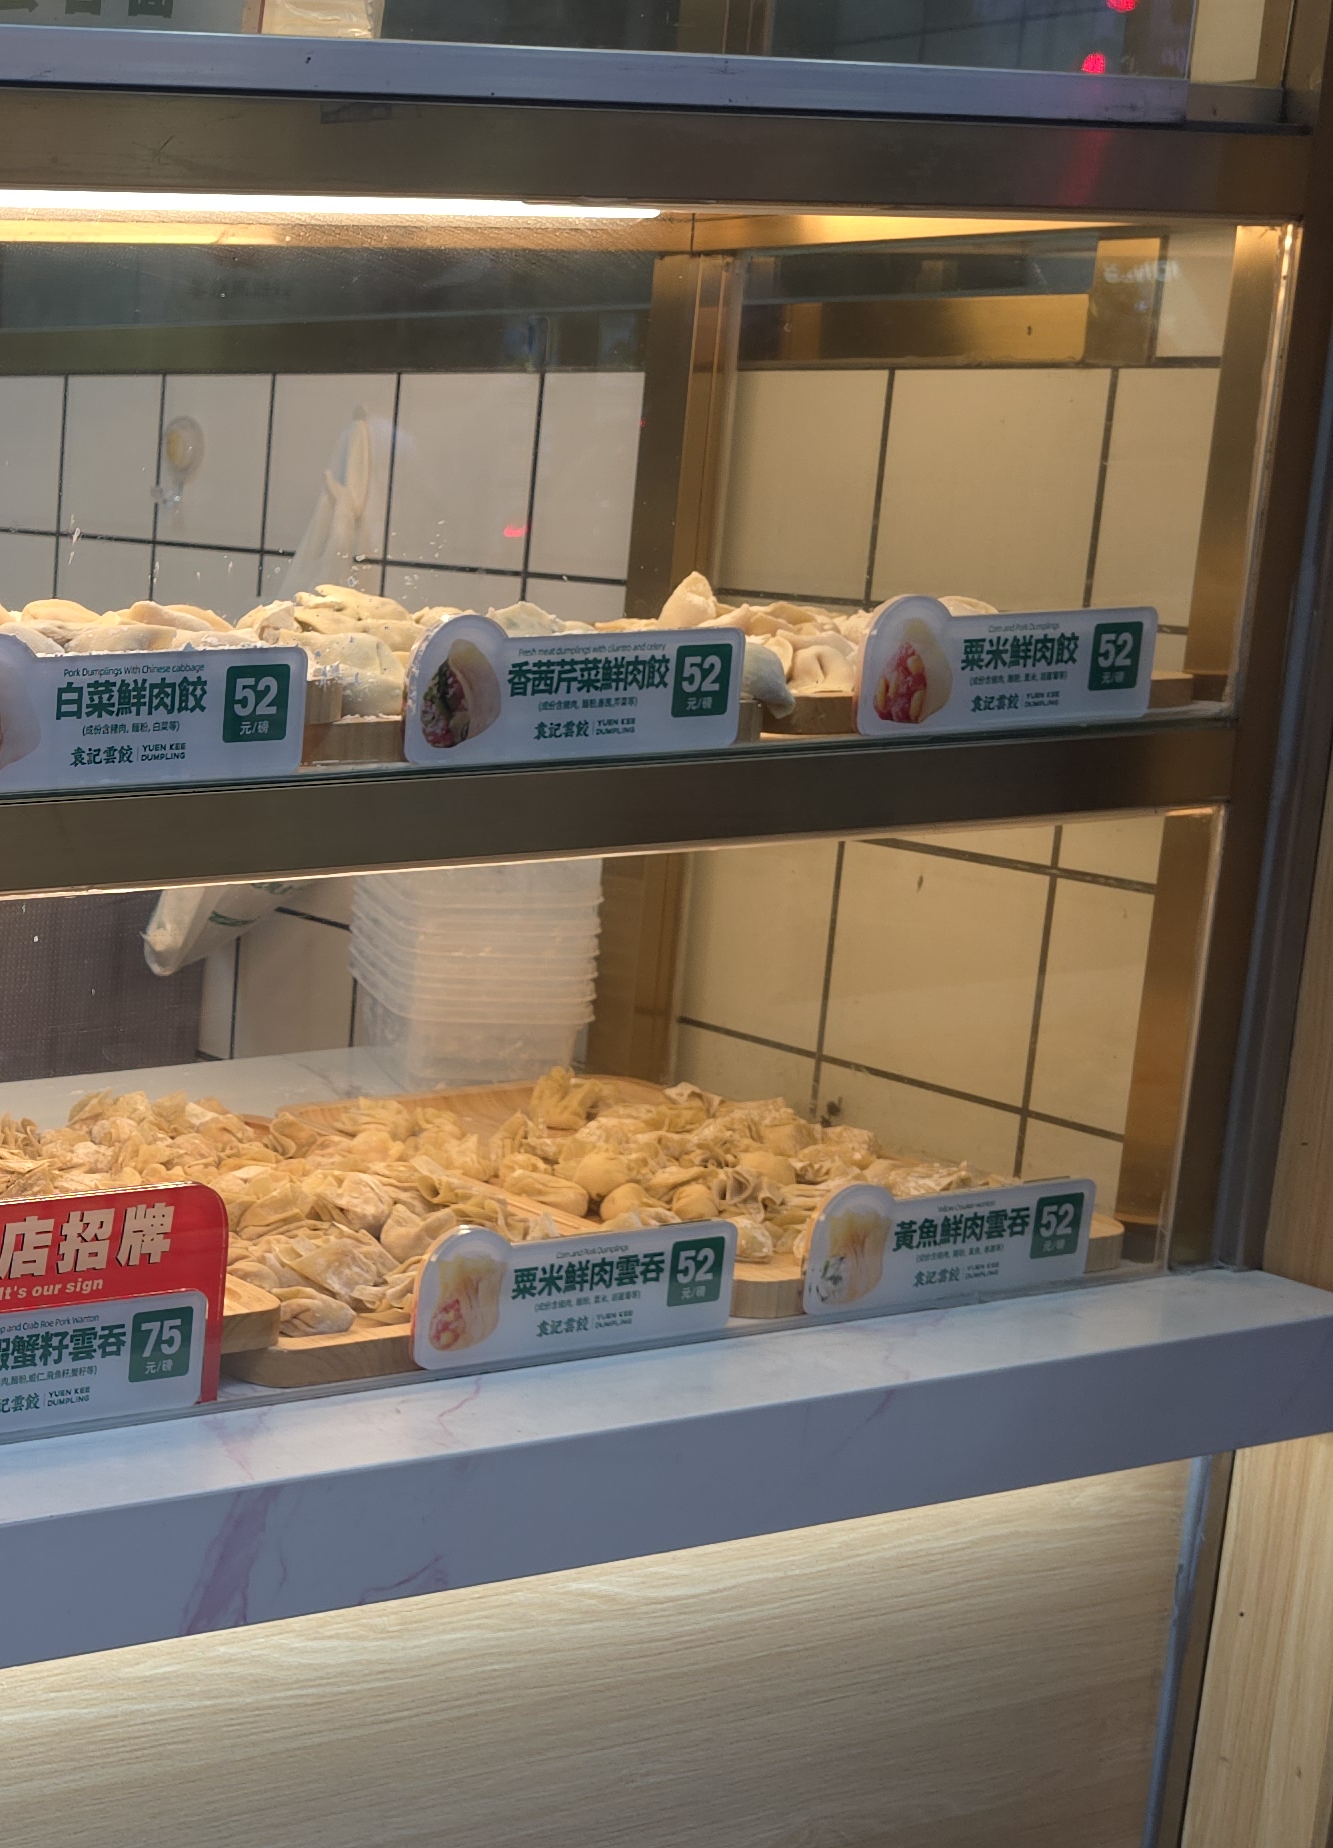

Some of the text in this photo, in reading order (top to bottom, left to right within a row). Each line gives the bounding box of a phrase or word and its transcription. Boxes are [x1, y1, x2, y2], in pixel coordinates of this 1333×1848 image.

[1097, 632, 1133, 668] 52
[64, 664, 205, 677] Pork Dumplings With Chinese cabbage
[507, 654, 670, 697] 香茜芹菜鮮肉餃
[681, 655, 722, 693] 52
[55, 675, 207, 720] 白菜鮮肉餃
[233, 676, 279, 717] 52
[239, 720, 270, 736] 元/磅
[70, 745, 134, 767] 袁記雲餃
[141, 752, 186, 762] DUMPLING
[142, 742, 186, 752] YUEN KEE
[892, 1206, 1030, 1252] 黃魚鮮肉雲吞
[1039, 1202, 1075, 1238] 52
[677, 1247, 716, 1284] 52
[32, 1283, 63, 1297] our
[65, 1277, 104, 1295] sign
[7, 1323, 21, 1332] and
[23, 1321, 39, 1331] Crab
[40, 1320, 54, 1328] Roe
[55, 1318, 71, 1327] Pork
[140, 1318, 183, 1358] 75
[145, 1359, 174, 1376] 元/磅
[47, 1395, 90, 1407] DUMPLING
[48, 1386, 90, 1398] YUEN KEE
